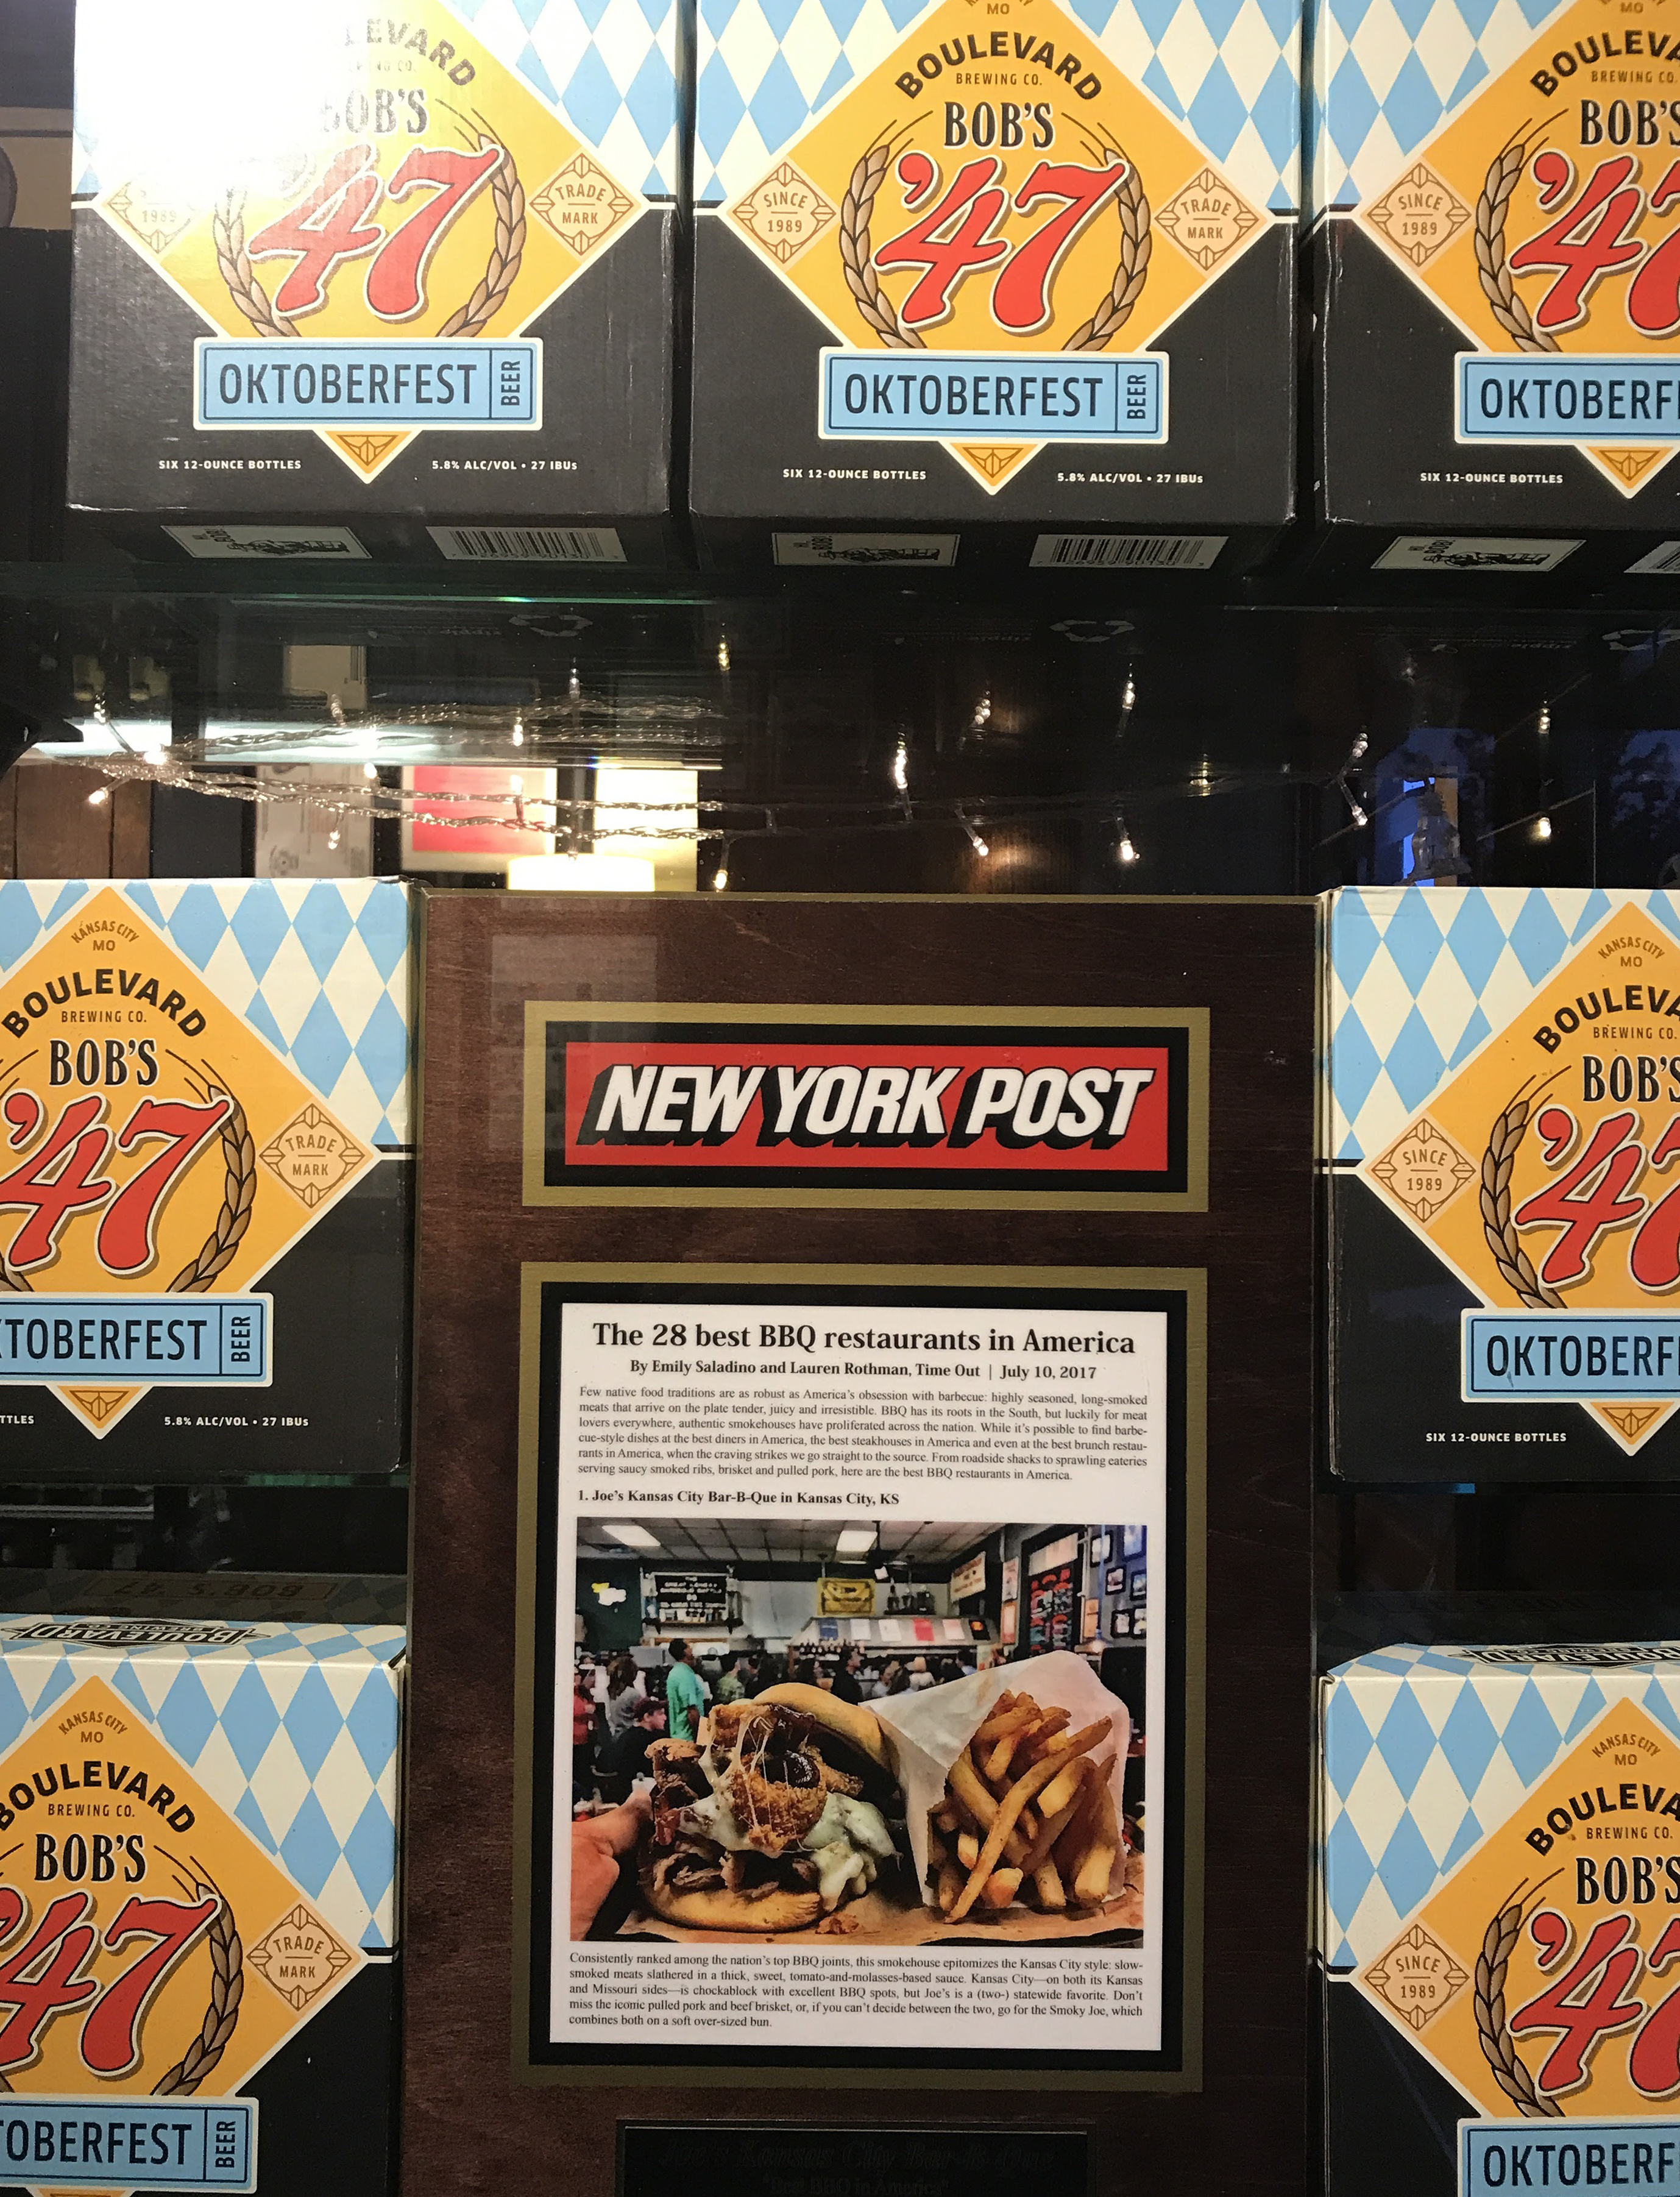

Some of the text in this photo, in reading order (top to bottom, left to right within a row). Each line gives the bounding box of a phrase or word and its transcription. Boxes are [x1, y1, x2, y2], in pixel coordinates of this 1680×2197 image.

[987, 3, 1010, 15] MO
[1620, 2, 1644, 13] MO
[895, 31, 1102, 99] BOULEVARD
[956, 73, 1043, 86] BREWING CO.
[1592, 70, 1679, 83] BREWING CO.
[944, 101, 1053, 148] BOB'S
[556, 183, 606, 202] TRADE
[764, 192, 809, 210] SINCE
[1181, 199, 1232, 219] TRADE
[1398, 193, 1443, 211] SINCE
[562, 211, 598, 225] MARK
[767, 218, 803, 233] 1989
[249, 145, 503, 318] 47
[1188, 226, 1224, 240] MARK
[1402, 222, 1437, 235] 1989
[219, 363, 473, 405] OKTOBERFEST
[501, 361, 520, 406] BEER
[845, 373, 1103, 417] OKTOBERFEST
[1127, 374, 1147, 419] BEER
[1481, 378, 1680, 420] OKTOBERF
[158, 460, 302, 470] SIX 12-OUNCE BOTTLES
[432, 460, 578, 471] 5.8% ALC/VOL 27 IBUs
[782, 469, 927, 480] SIX 12-OUNCE BOTTLES
[1057, 472, 1204, 483] 5.8% ALC/VOL 27 IBUs
[1420, 472, 1564, 484] SIX 12-OUNCE BOTTLES
[71, 920, 140, 943] KANSAS CITY
[93, 940, 116, 951] MO
[1598, 937, 1665, 959] KANSAS CITY
[1620, 956, 1643, 967] MO
[1, 968, 207, 1038] BOULEVARD
[61, 1010, 147, 1023] BREWING CO.
[1593, 1026, 1678, 1040] BREWING CO.
[49, 1039, 158, 1086] BOB'S
[585, 1065, 1156, 1145] NEW YORK POST
[285, 1135, 338, 1152] TRADE
[1402, 1148, 1448, 1166] SINCE
[292, 1164, 329, 1177] MARK
[1407, 1177, 1442, 1191] 1989
[0, 1318, 207, 1361] TOBERFEST
[231, 1315, 250, 1362] BEER
[593, 1322, 1135, 1354] The 28 best BBQ restaurants in America
[1486, 1335, 1680, 1377] OKTOBERF
[630, 1360, 1097, 1381] By Emily Saladino and Lauren Rothman, Time Out July 10, 2017
[580, 1386, 601, 1396] Few
[606, 1387, 636, 1397] native
[641, 1387, 663, 1397] food
[668, 1388, 715, 1397] traditions
[754, 1389, 785, 1398] robust
[803, 1390, 854, 1399] America's
[859, 1390, 907, 1400] obsession
[912, 1391, 934, 1400] with
[938, 1391, 987, 1402] barbecue:
[991, 1392, 1024, 1405] highly
[1028, 1394, 1077, 1404] seasoned,
[1082, 1394, 1147, 1407] long-smoked
[164, 1416, 309, 1427] 5.8% ALC/VOL 27 IBUs
[1426, 1433, 1567, 1443] SIX 12-OUNCE BOTTLES
[579, 1490, 899, 1507] 1. Joe's Kansas City Bar-B-Que in Kansas City, KS
[58, 1711, 127, 1735] KANSAS CITY
[80, 1731, 104, 1743] MO
[1592, 1733, 1661, 1758] KANSAS CITY
[1614, 1754, 1637, 1766] MO
[0, 1761, 196, 1833] BOULEVARD
[48, 1803, 135, 1817] BREWING CO.
[1586, 1826, 1673, 1839] BREWING CO.
[34, 1833, 146, 1882] BOB'S
[273, 1935, 325, 1954] TRADE
[279, 1965, 316, 1979] MARK
[1395, 1955, 1441, 1973] SINCE
[1401, 1985, 1435, 1999] 1989
[569, 2015, 618, 2025] combines
[622, 2015, 643, 2025] both
[672, 2015, 691, 2025] soft
[694, 2017, 746, 2026] over-sized
[751, 2017, 771, 2027] bun.
[0, 2120, 192, 2165] OBERFEST
[215, 2120, 236, 2169] BEER
